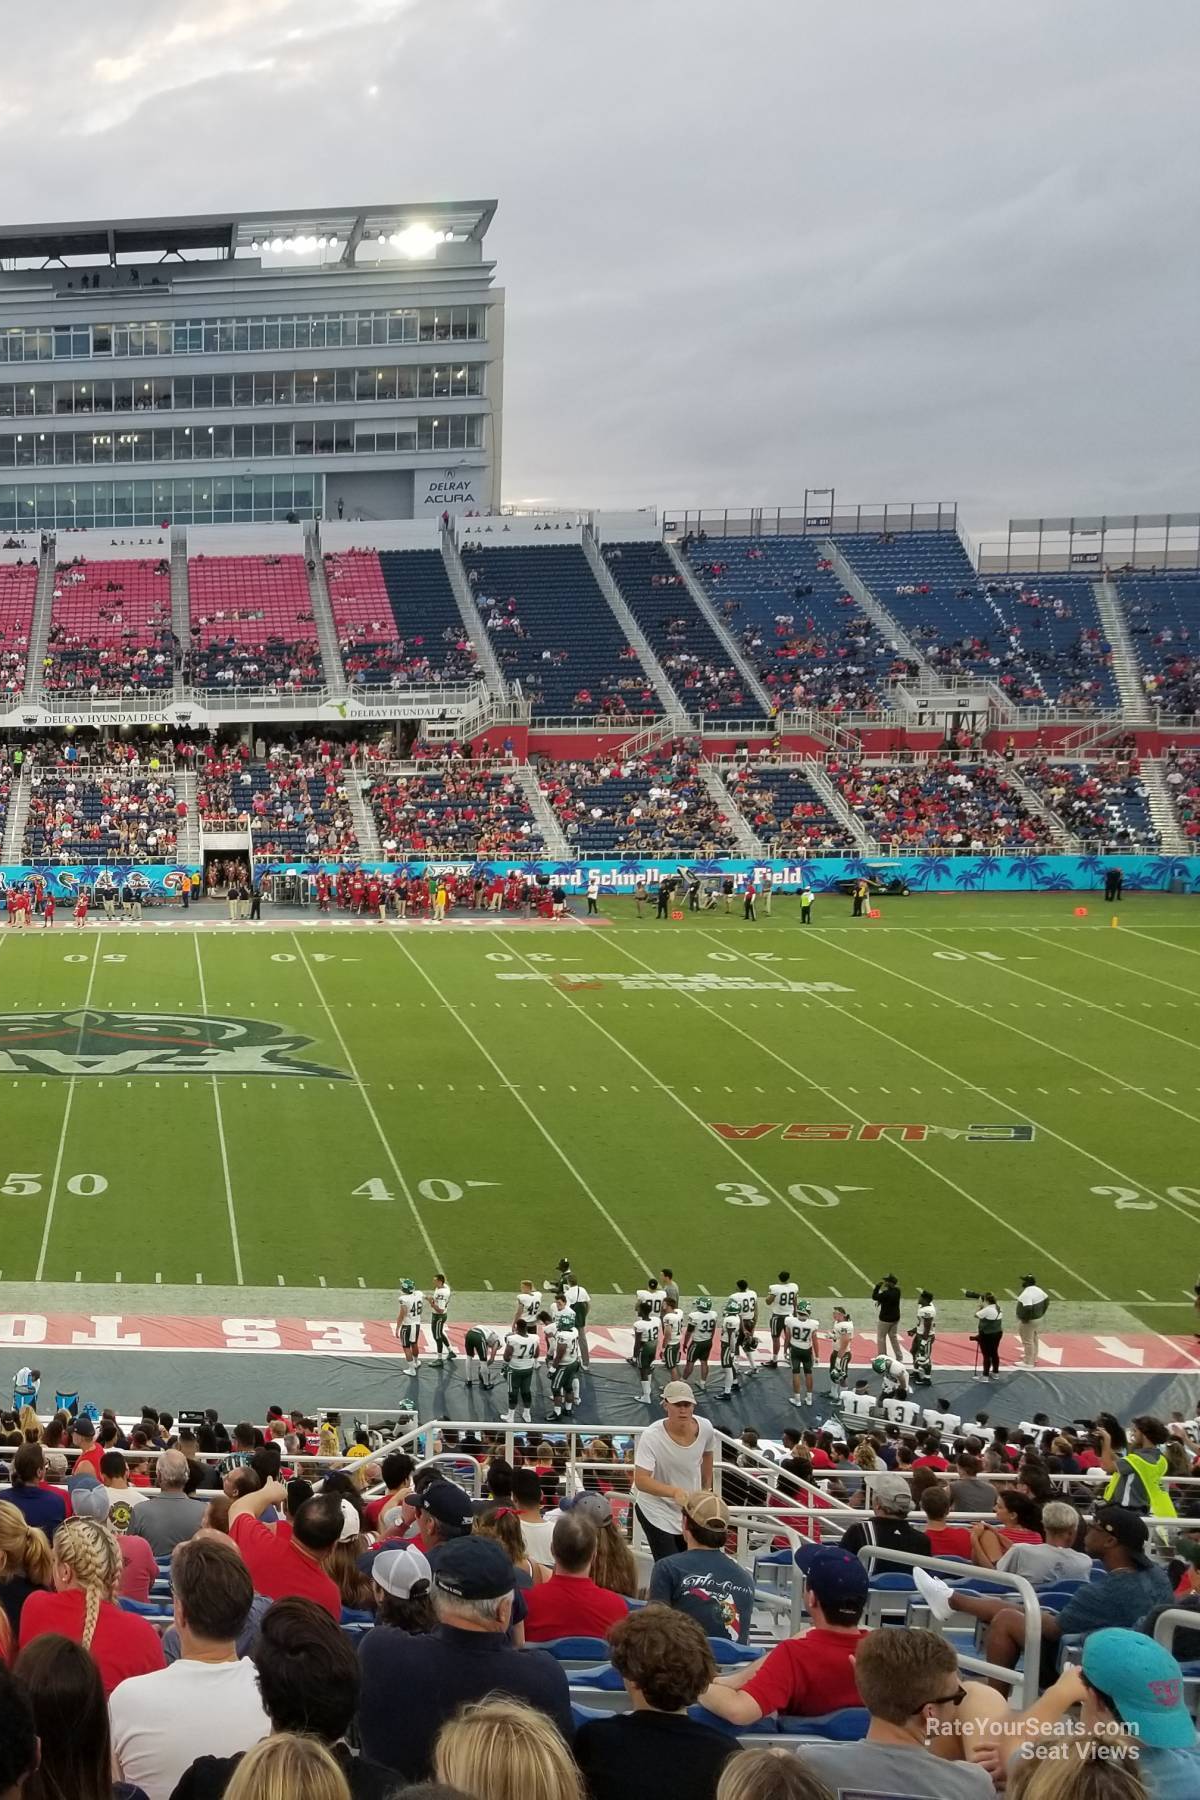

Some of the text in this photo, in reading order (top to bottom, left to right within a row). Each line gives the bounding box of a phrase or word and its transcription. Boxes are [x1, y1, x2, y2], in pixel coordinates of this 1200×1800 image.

[429, 481, 471, 491] DELRAY
[424, 493, 475, 504] ACURA
[44, 712, 169, 725] DELRAY HYUNDAI DECK
[351, 709, 388, 719] DELRAY
[389, 707, 436, 718] HYUNDAI
[753, 867, 801, 885] Field
[62, 953, 129, 963] 50
[270, 953, 338, 963] 40
[485, 952, 556, 963] 30
[707, 952, 783, 962] 20
[931, 951, 1007, 962] 10
[0, 1172, 109, 1196] 50
[350, 1176, 464, 1203] 40
[714, 1181, 841, 1208] 30
[742, 1298, 756, 1312] 83
[779, 1292, 795, 1306] 88
[701, 1319, 715, 1333] 39
[647, 1327, 659, 1341] 12
[791, 1327, 810, 1341] 87
[519, 1344, 536, 1359] 74
[853, 1400, 859, 1414] 1
[894, 1406, 905, 1423] 3
